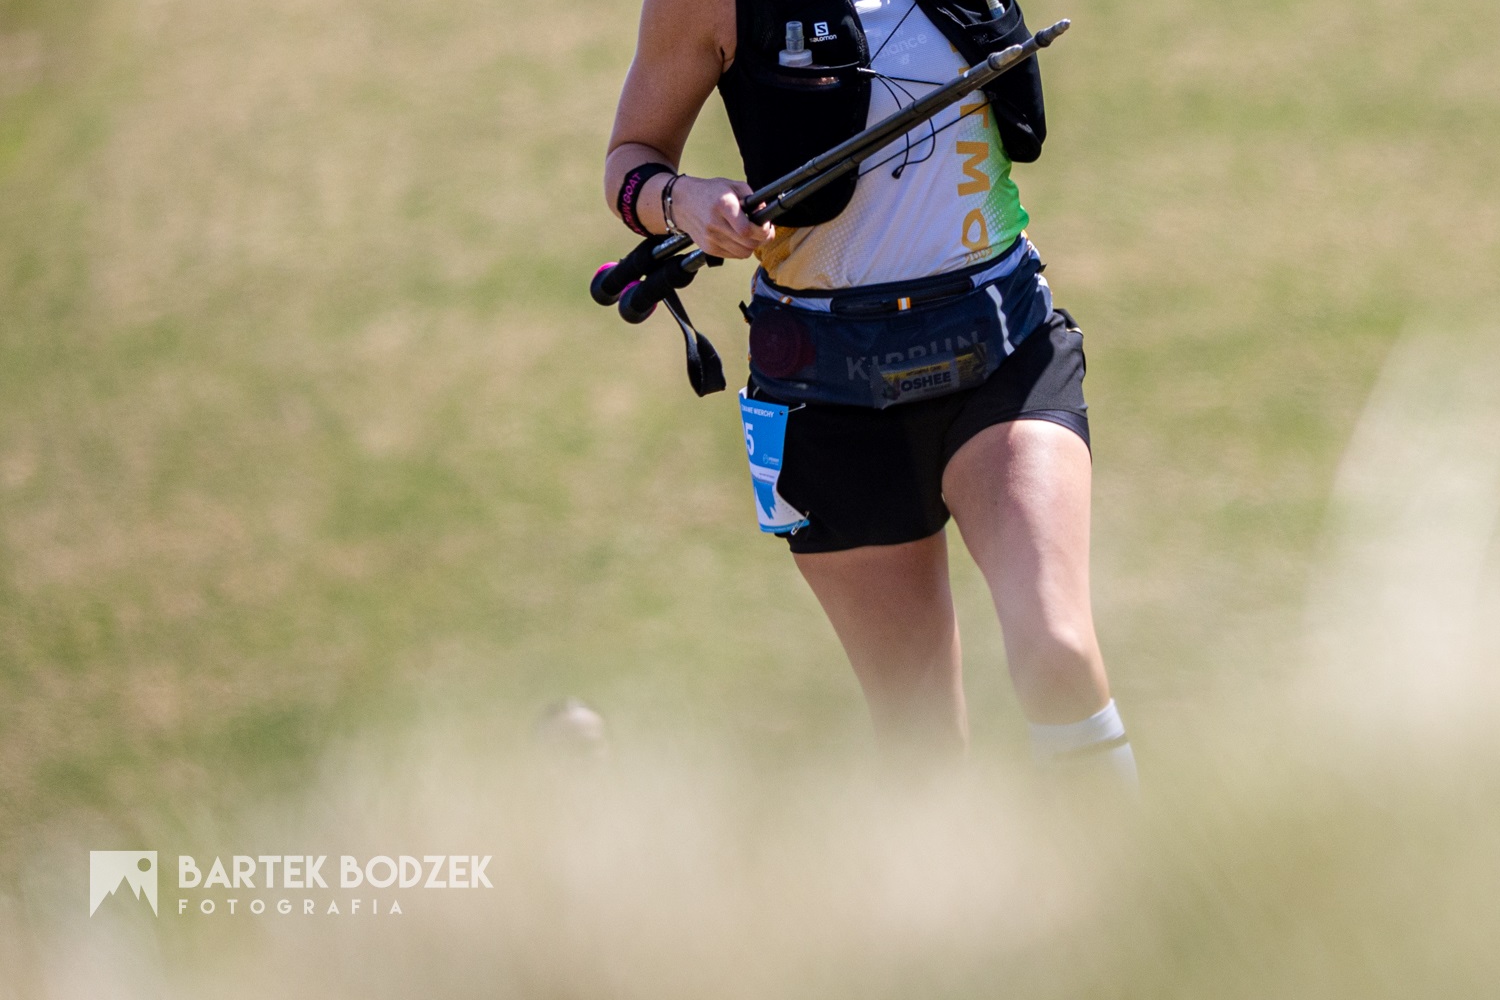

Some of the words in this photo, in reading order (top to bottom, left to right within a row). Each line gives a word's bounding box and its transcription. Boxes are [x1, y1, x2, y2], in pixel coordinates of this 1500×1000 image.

[623, 172, 640, 204] GOAT
[901, 371, 951, 392] OSHEE
[745, 422, 754, 456] 5
